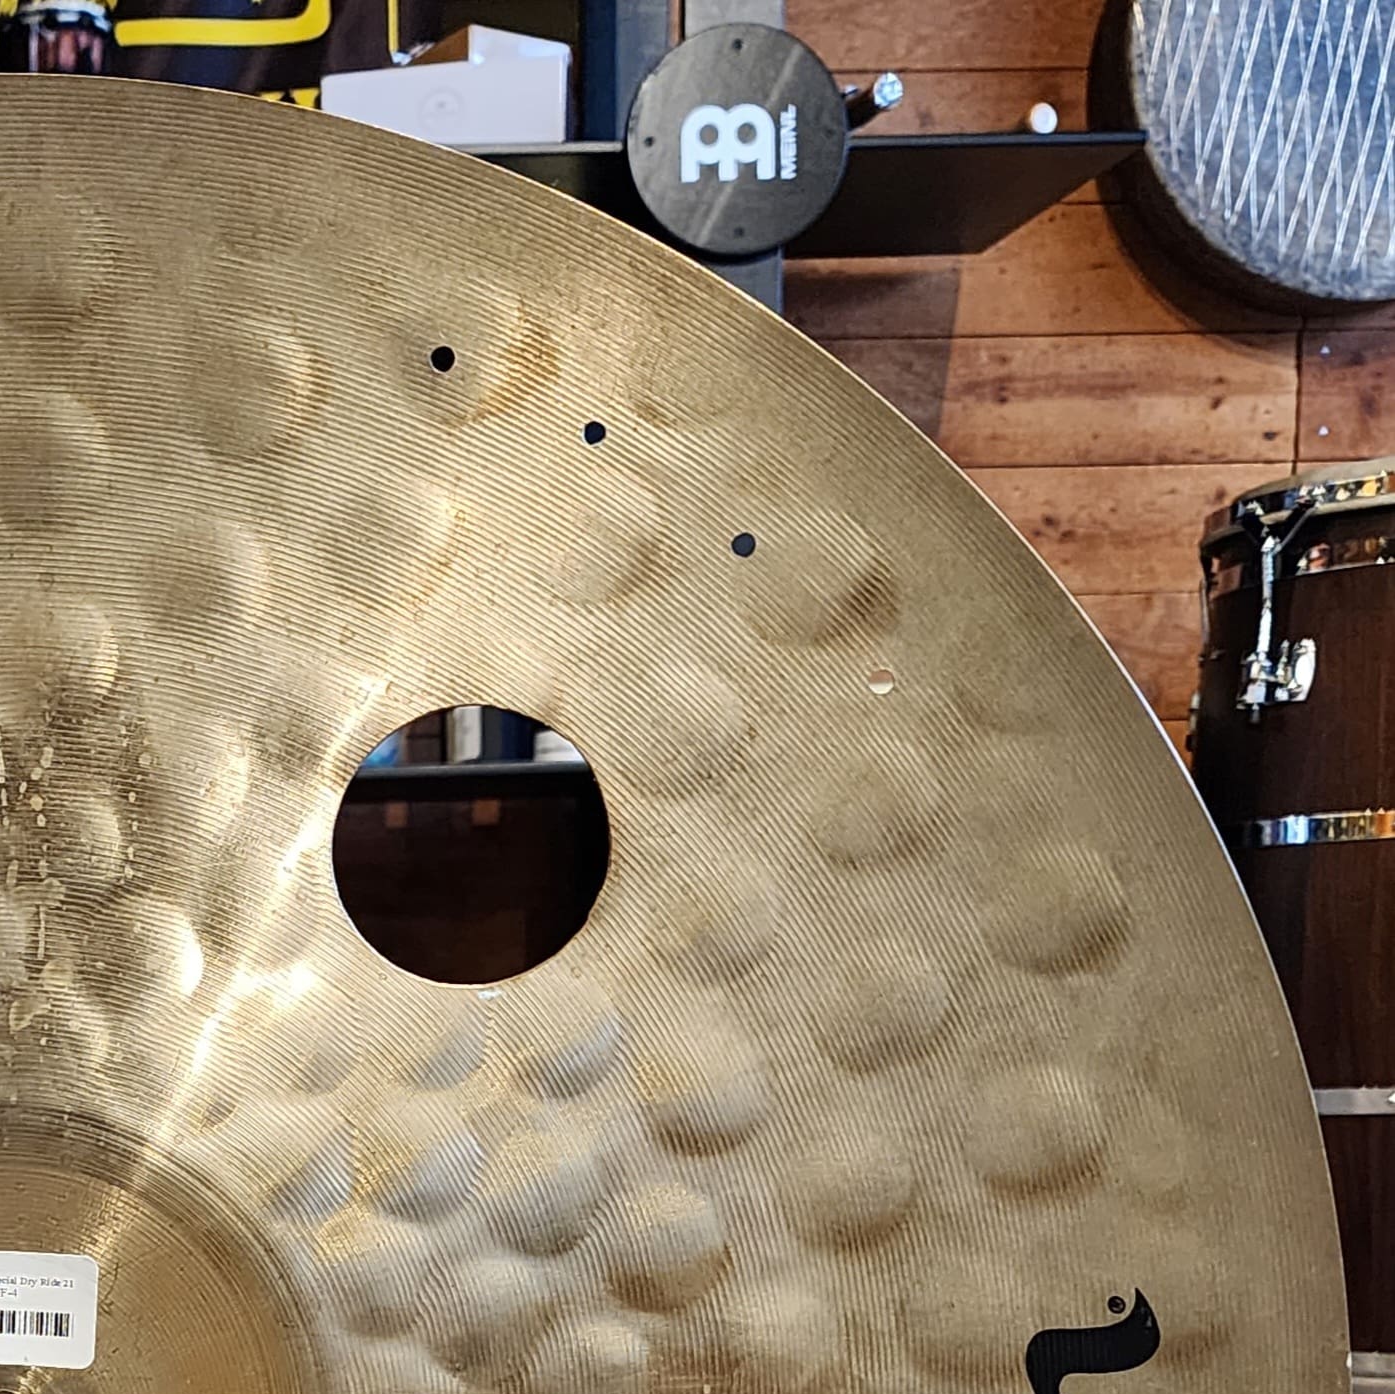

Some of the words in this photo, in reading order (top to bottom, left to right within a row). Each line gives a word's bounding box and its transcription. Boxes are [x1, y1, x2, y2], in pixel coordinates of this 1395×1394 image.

[780, 103, 798, 180] MEINL
[20, 1277, 38, 1288] Dry
[40, 1278, 61, 1287] Ride
[62, 1279, 74, 1288] 21
